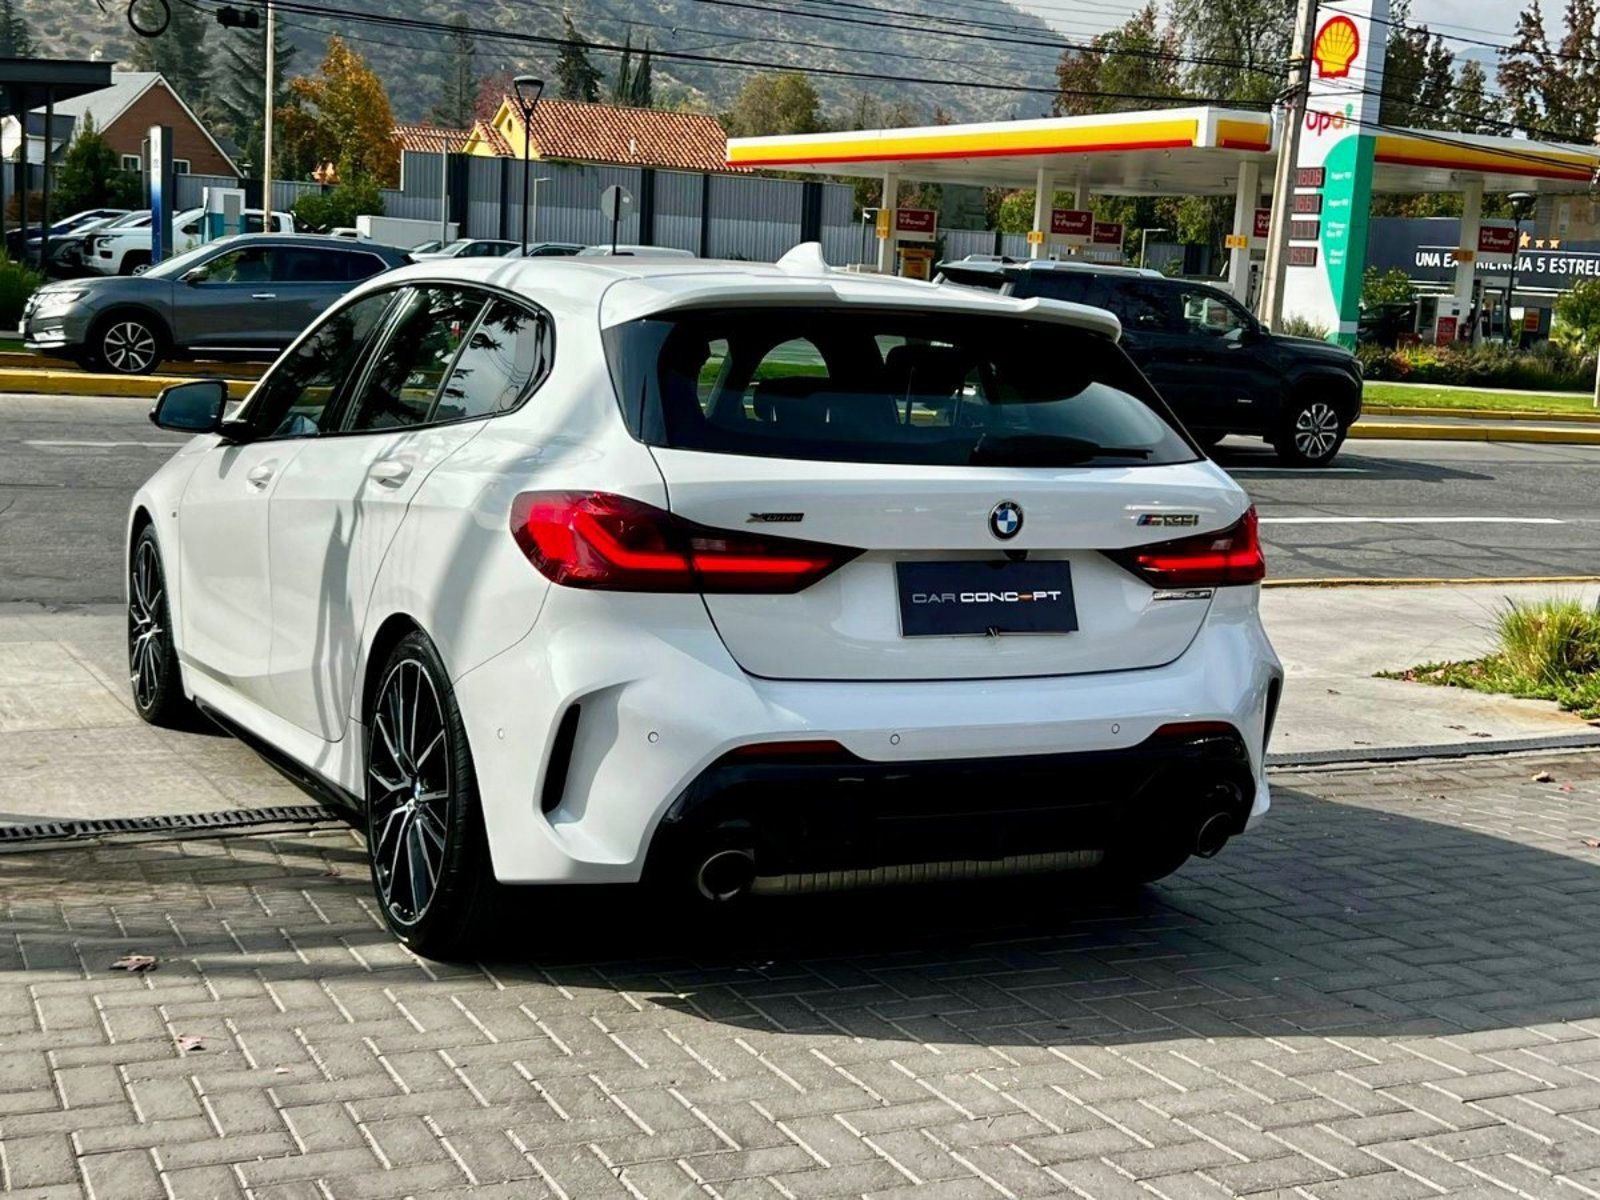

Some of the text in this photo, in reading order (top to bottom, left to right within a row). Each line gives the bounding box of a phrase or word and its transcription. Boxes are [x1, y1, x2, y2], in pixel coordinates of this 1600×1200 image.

[1415, 252, 1441, 267] UNA
[1536, 257, 1546, 273] 5
[912, 593, 956, 604] CAR
